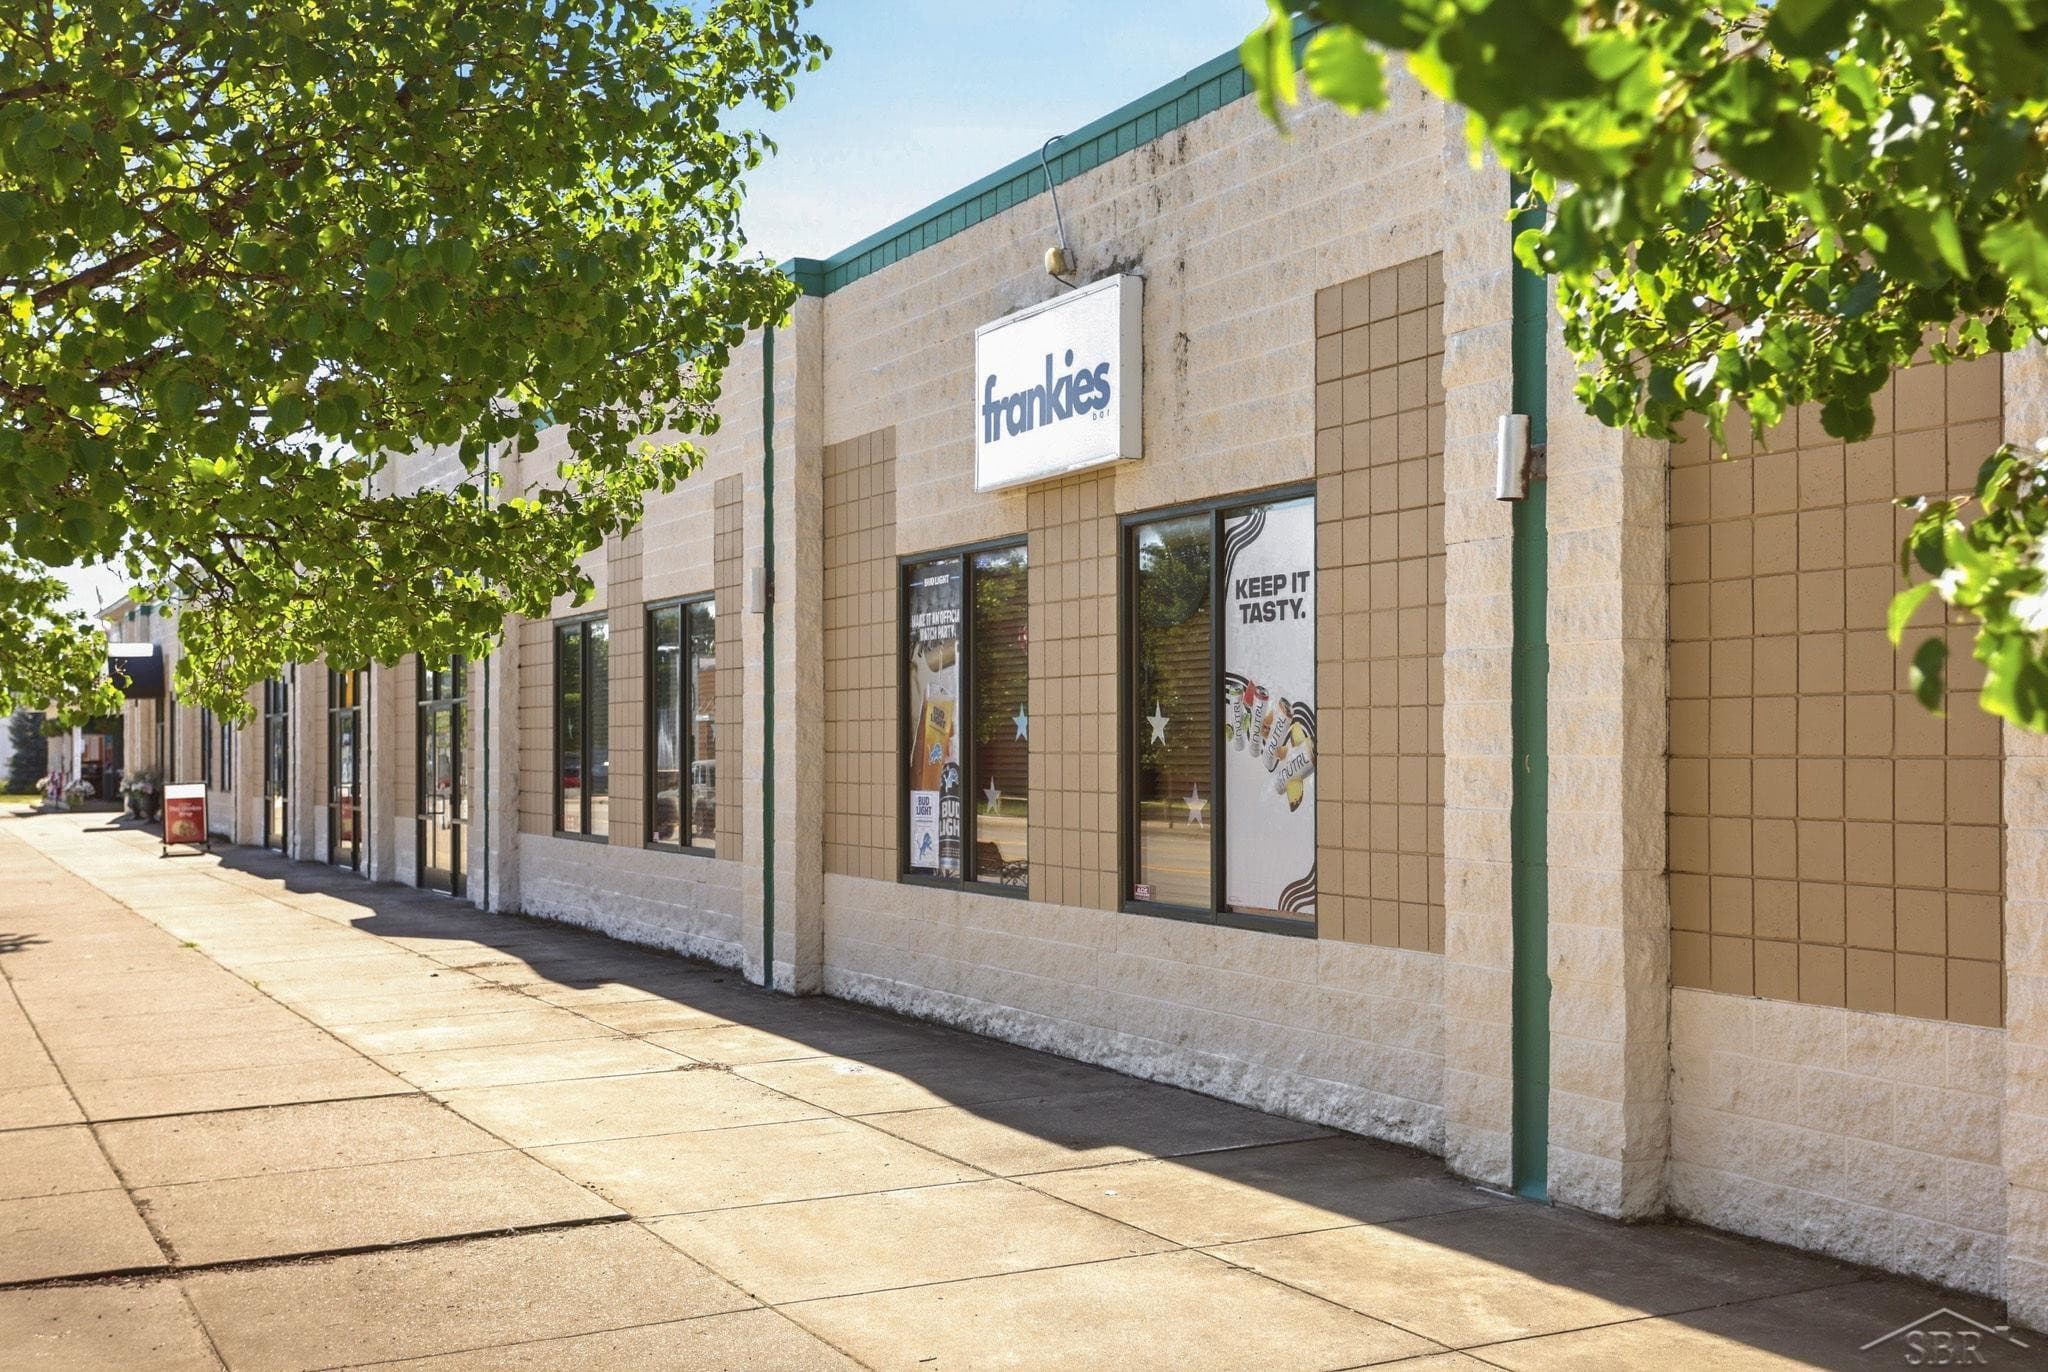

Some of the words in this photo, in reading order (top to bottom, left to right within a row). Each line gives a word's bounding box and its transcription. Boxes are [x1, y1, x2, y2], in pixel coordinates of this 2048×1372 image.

[982, 349, 1111, 444] frankies
[924, 577, 935, 587] BUD
[935, 574, 949, 585] LIGHT
[1235, 574, 1287, 600] KEEP
[1291, 570, 1310, 593] IT
[1239, 598, 1306, 624] TASTY.
[915, 806, 932, 816] LIGHT
[917, 797, 930, 806] BUD
